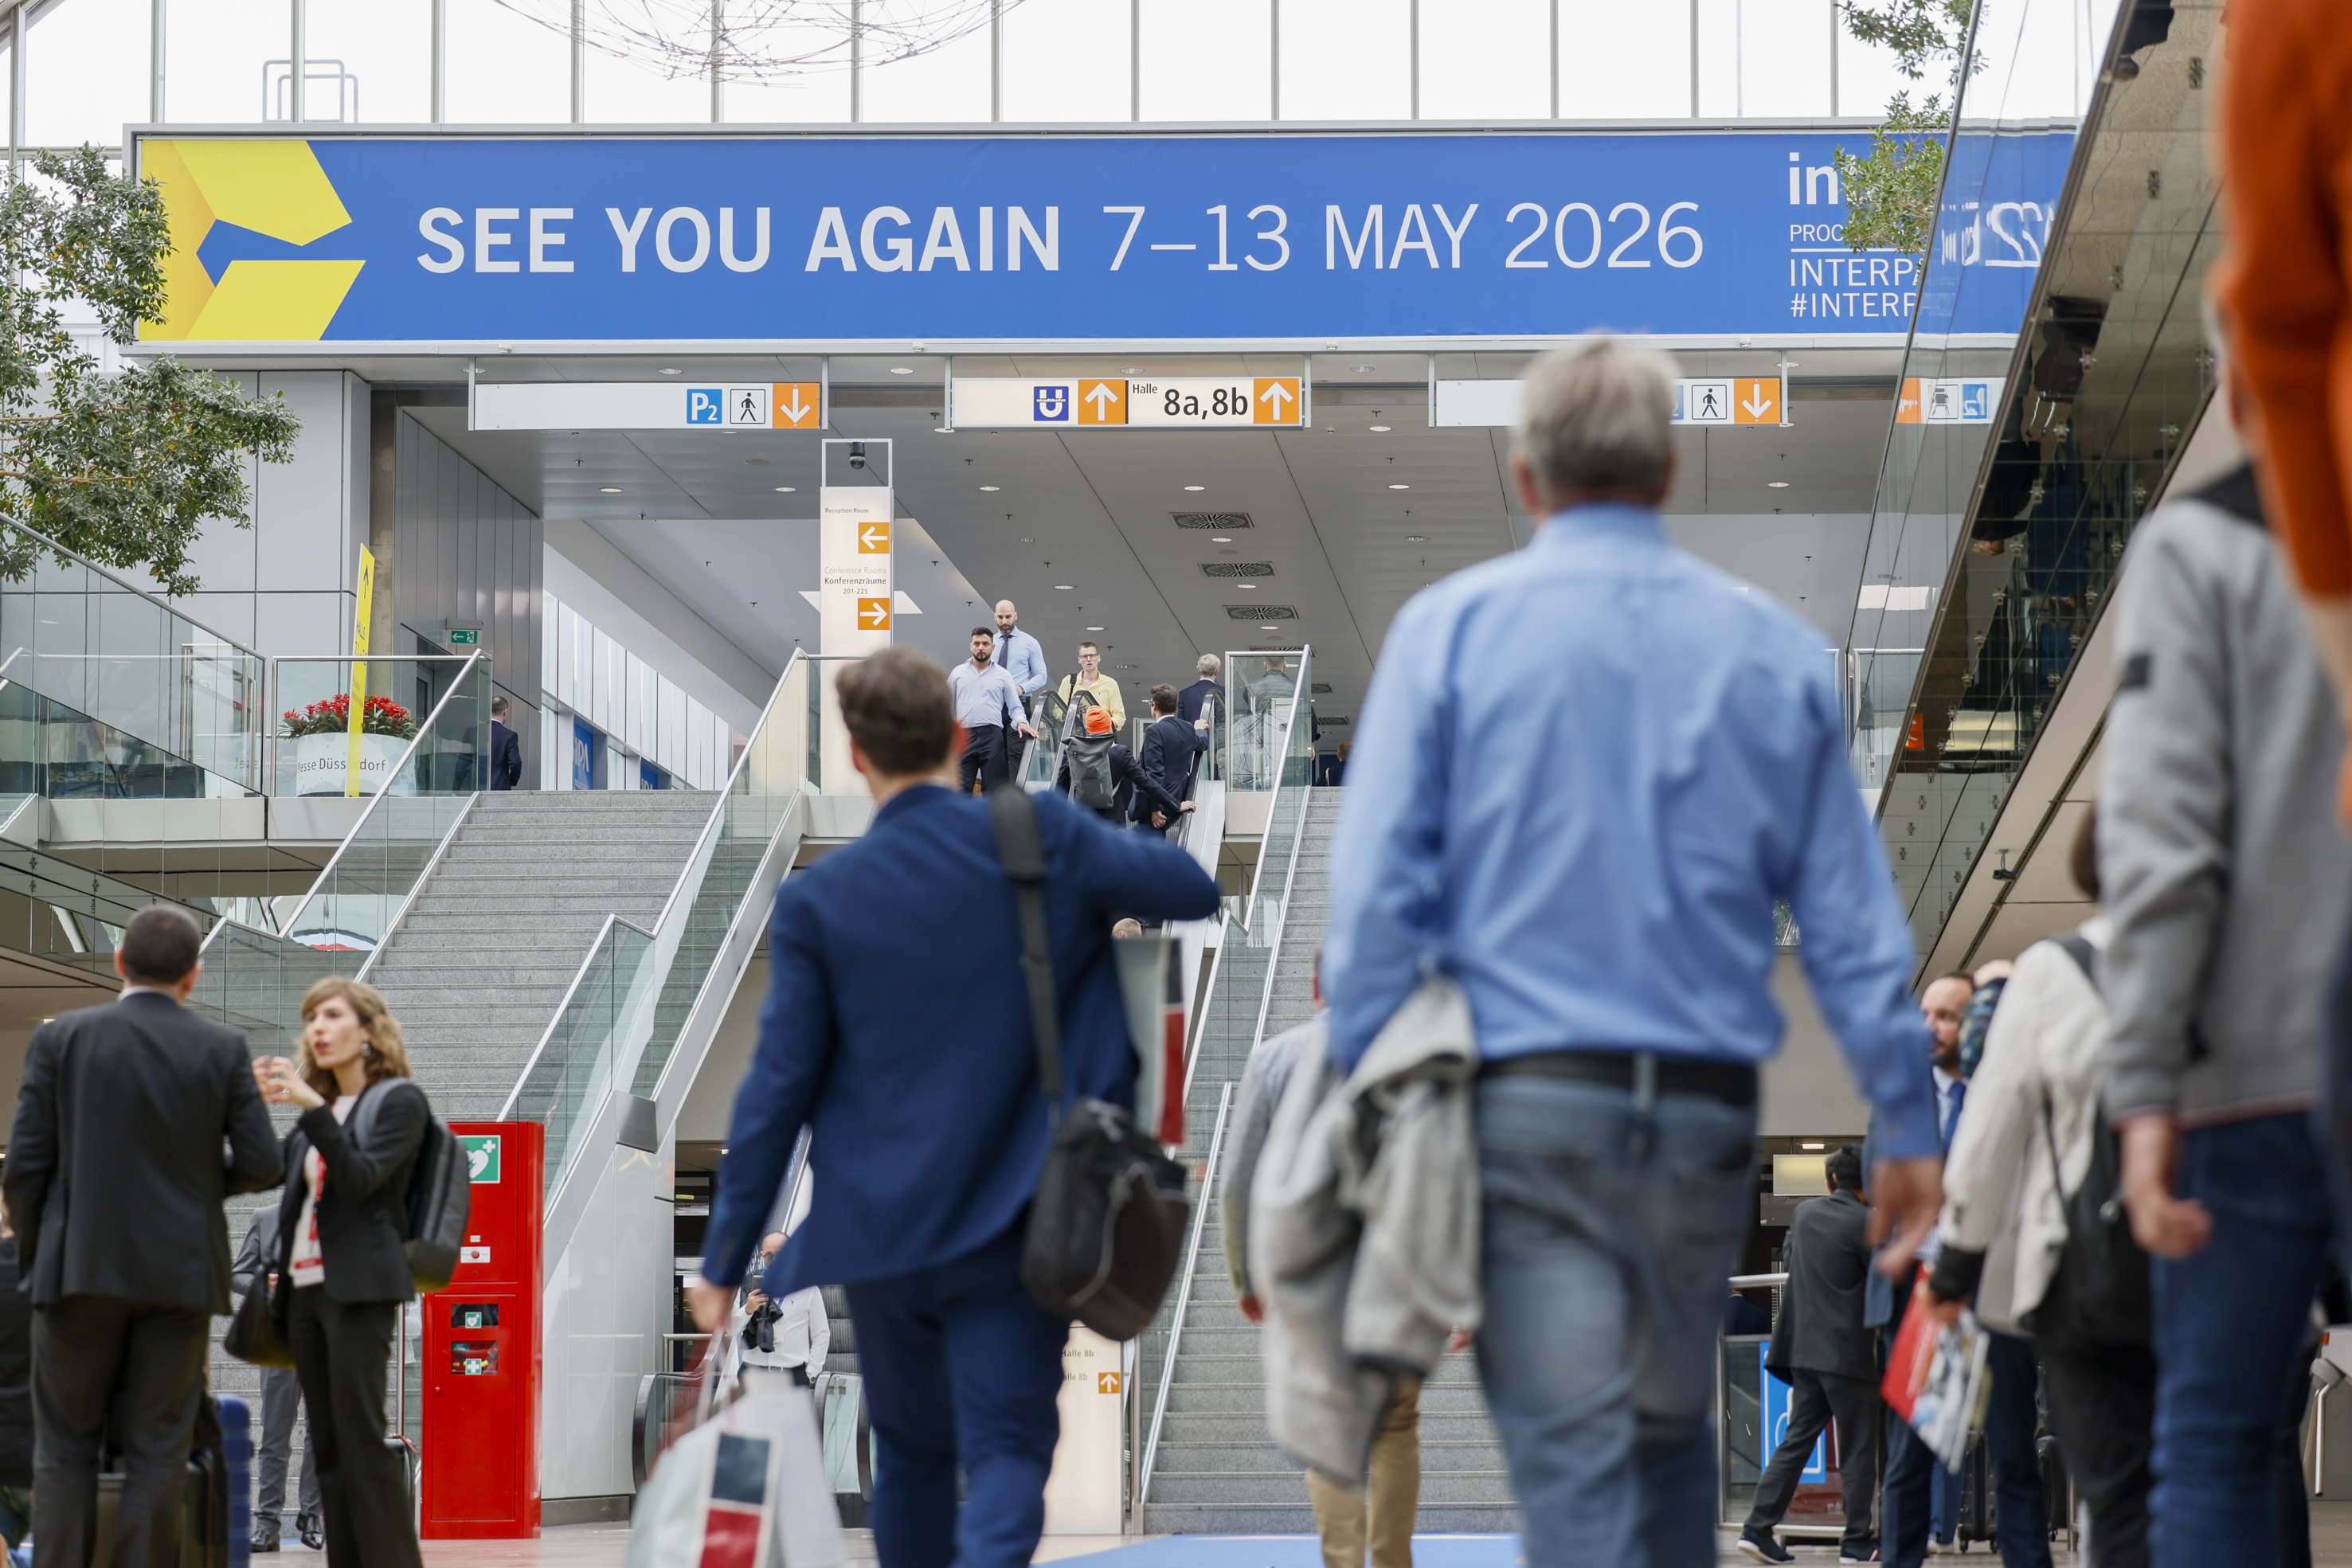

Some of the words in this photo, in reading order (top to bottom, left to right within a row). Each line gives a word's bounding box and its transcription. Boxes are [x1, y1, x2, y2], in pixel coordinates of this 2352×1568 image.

[417, 207, 574, 274] SEE
[605, 206, 770, 273] YOU
[804, 205, 1059, 272] AGAIN
[1325, 203, 1479, 270] MAY
[1505, 201, 1703, 269] 2026
[1133, 383, 1158, 394] Halle
[691, 392, 718, 421] P2
[1164, 387, 1248, 420] 8a,8b
[319, 757, 386, 771] Düssdorf
